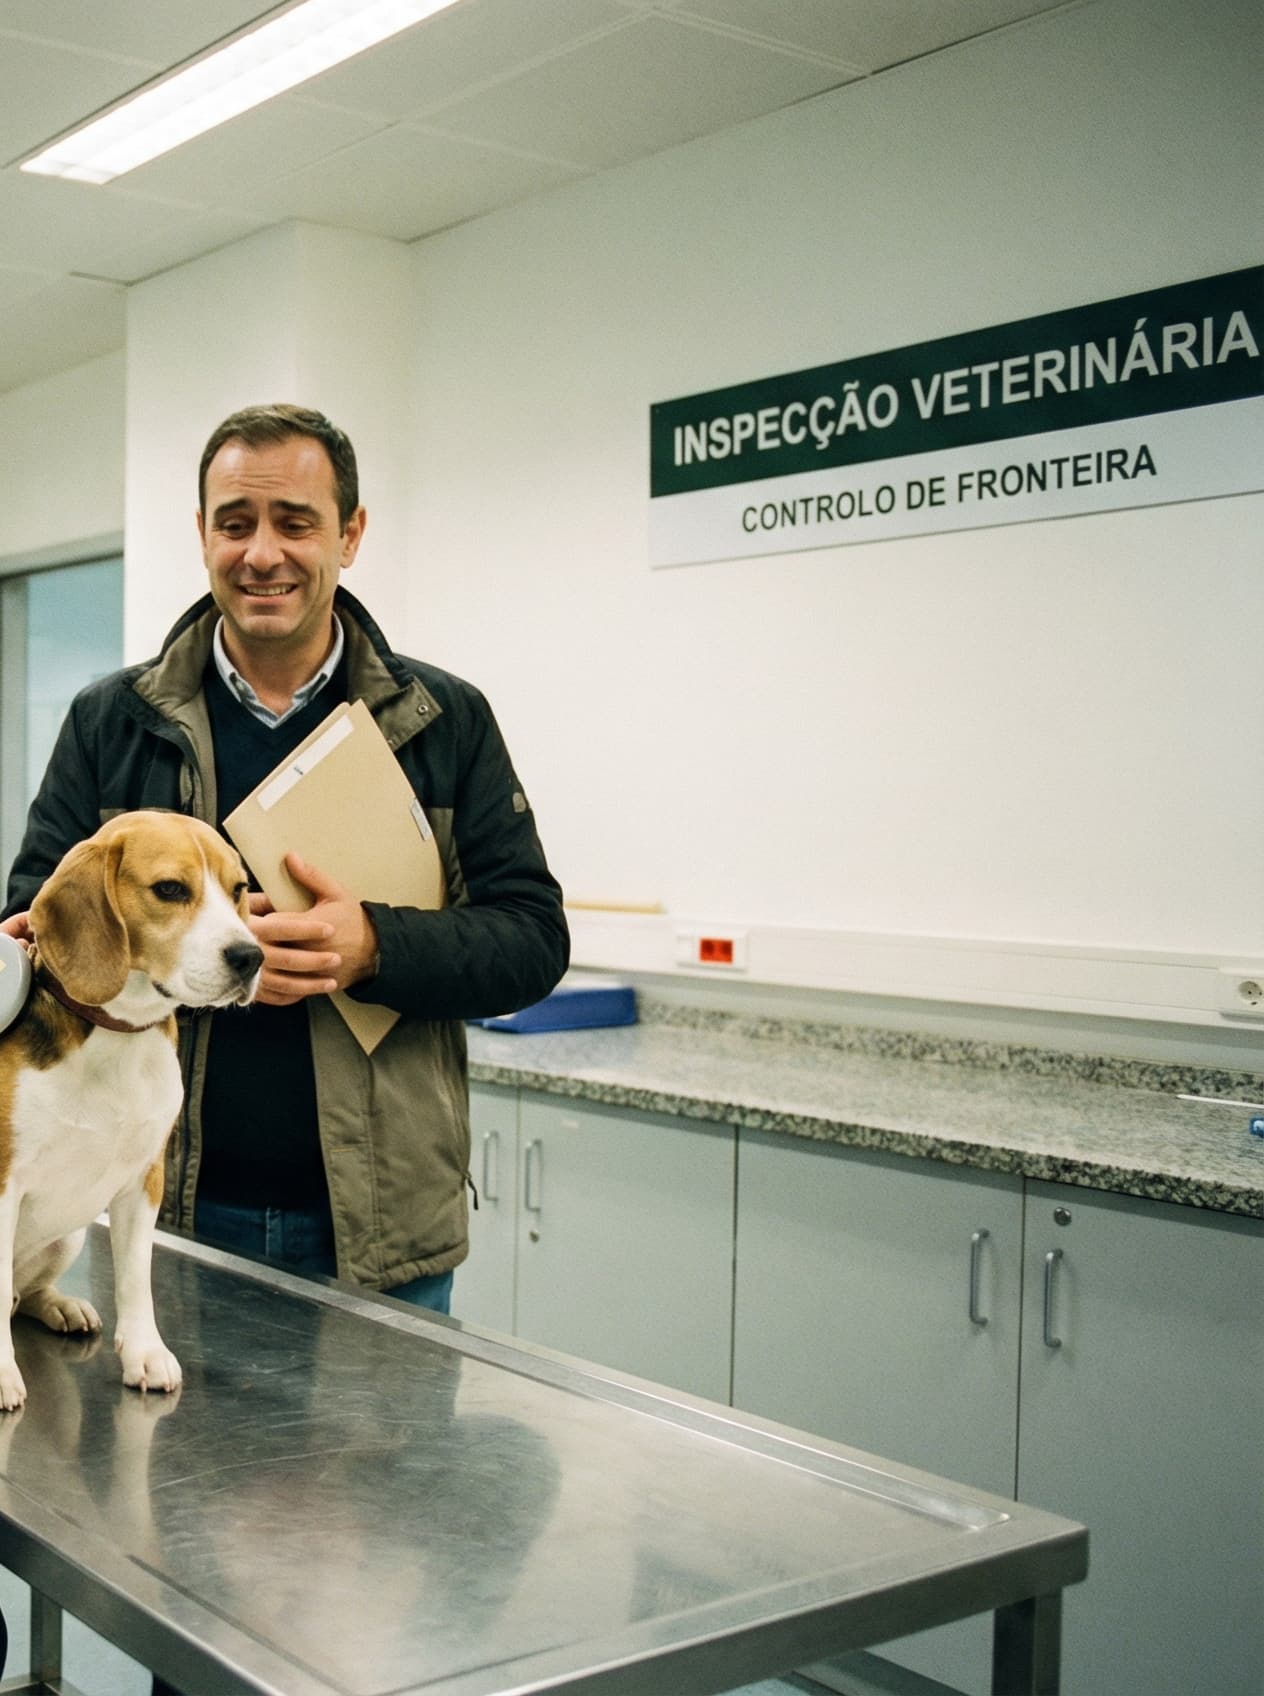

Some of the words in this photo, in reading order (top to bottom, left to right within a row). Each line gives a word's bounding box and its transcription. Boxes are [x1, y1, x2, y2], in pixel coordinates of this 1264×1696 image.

[674, 382, 898, 466] INSPECÇÃO
[910, 310, 1260, 420] VETERINÁRIA
[742, 485, 895, 532] CONTROLO
[906, 476, 946, 510] DE
[957, 444, 1157, 503] FRONTEIRA
